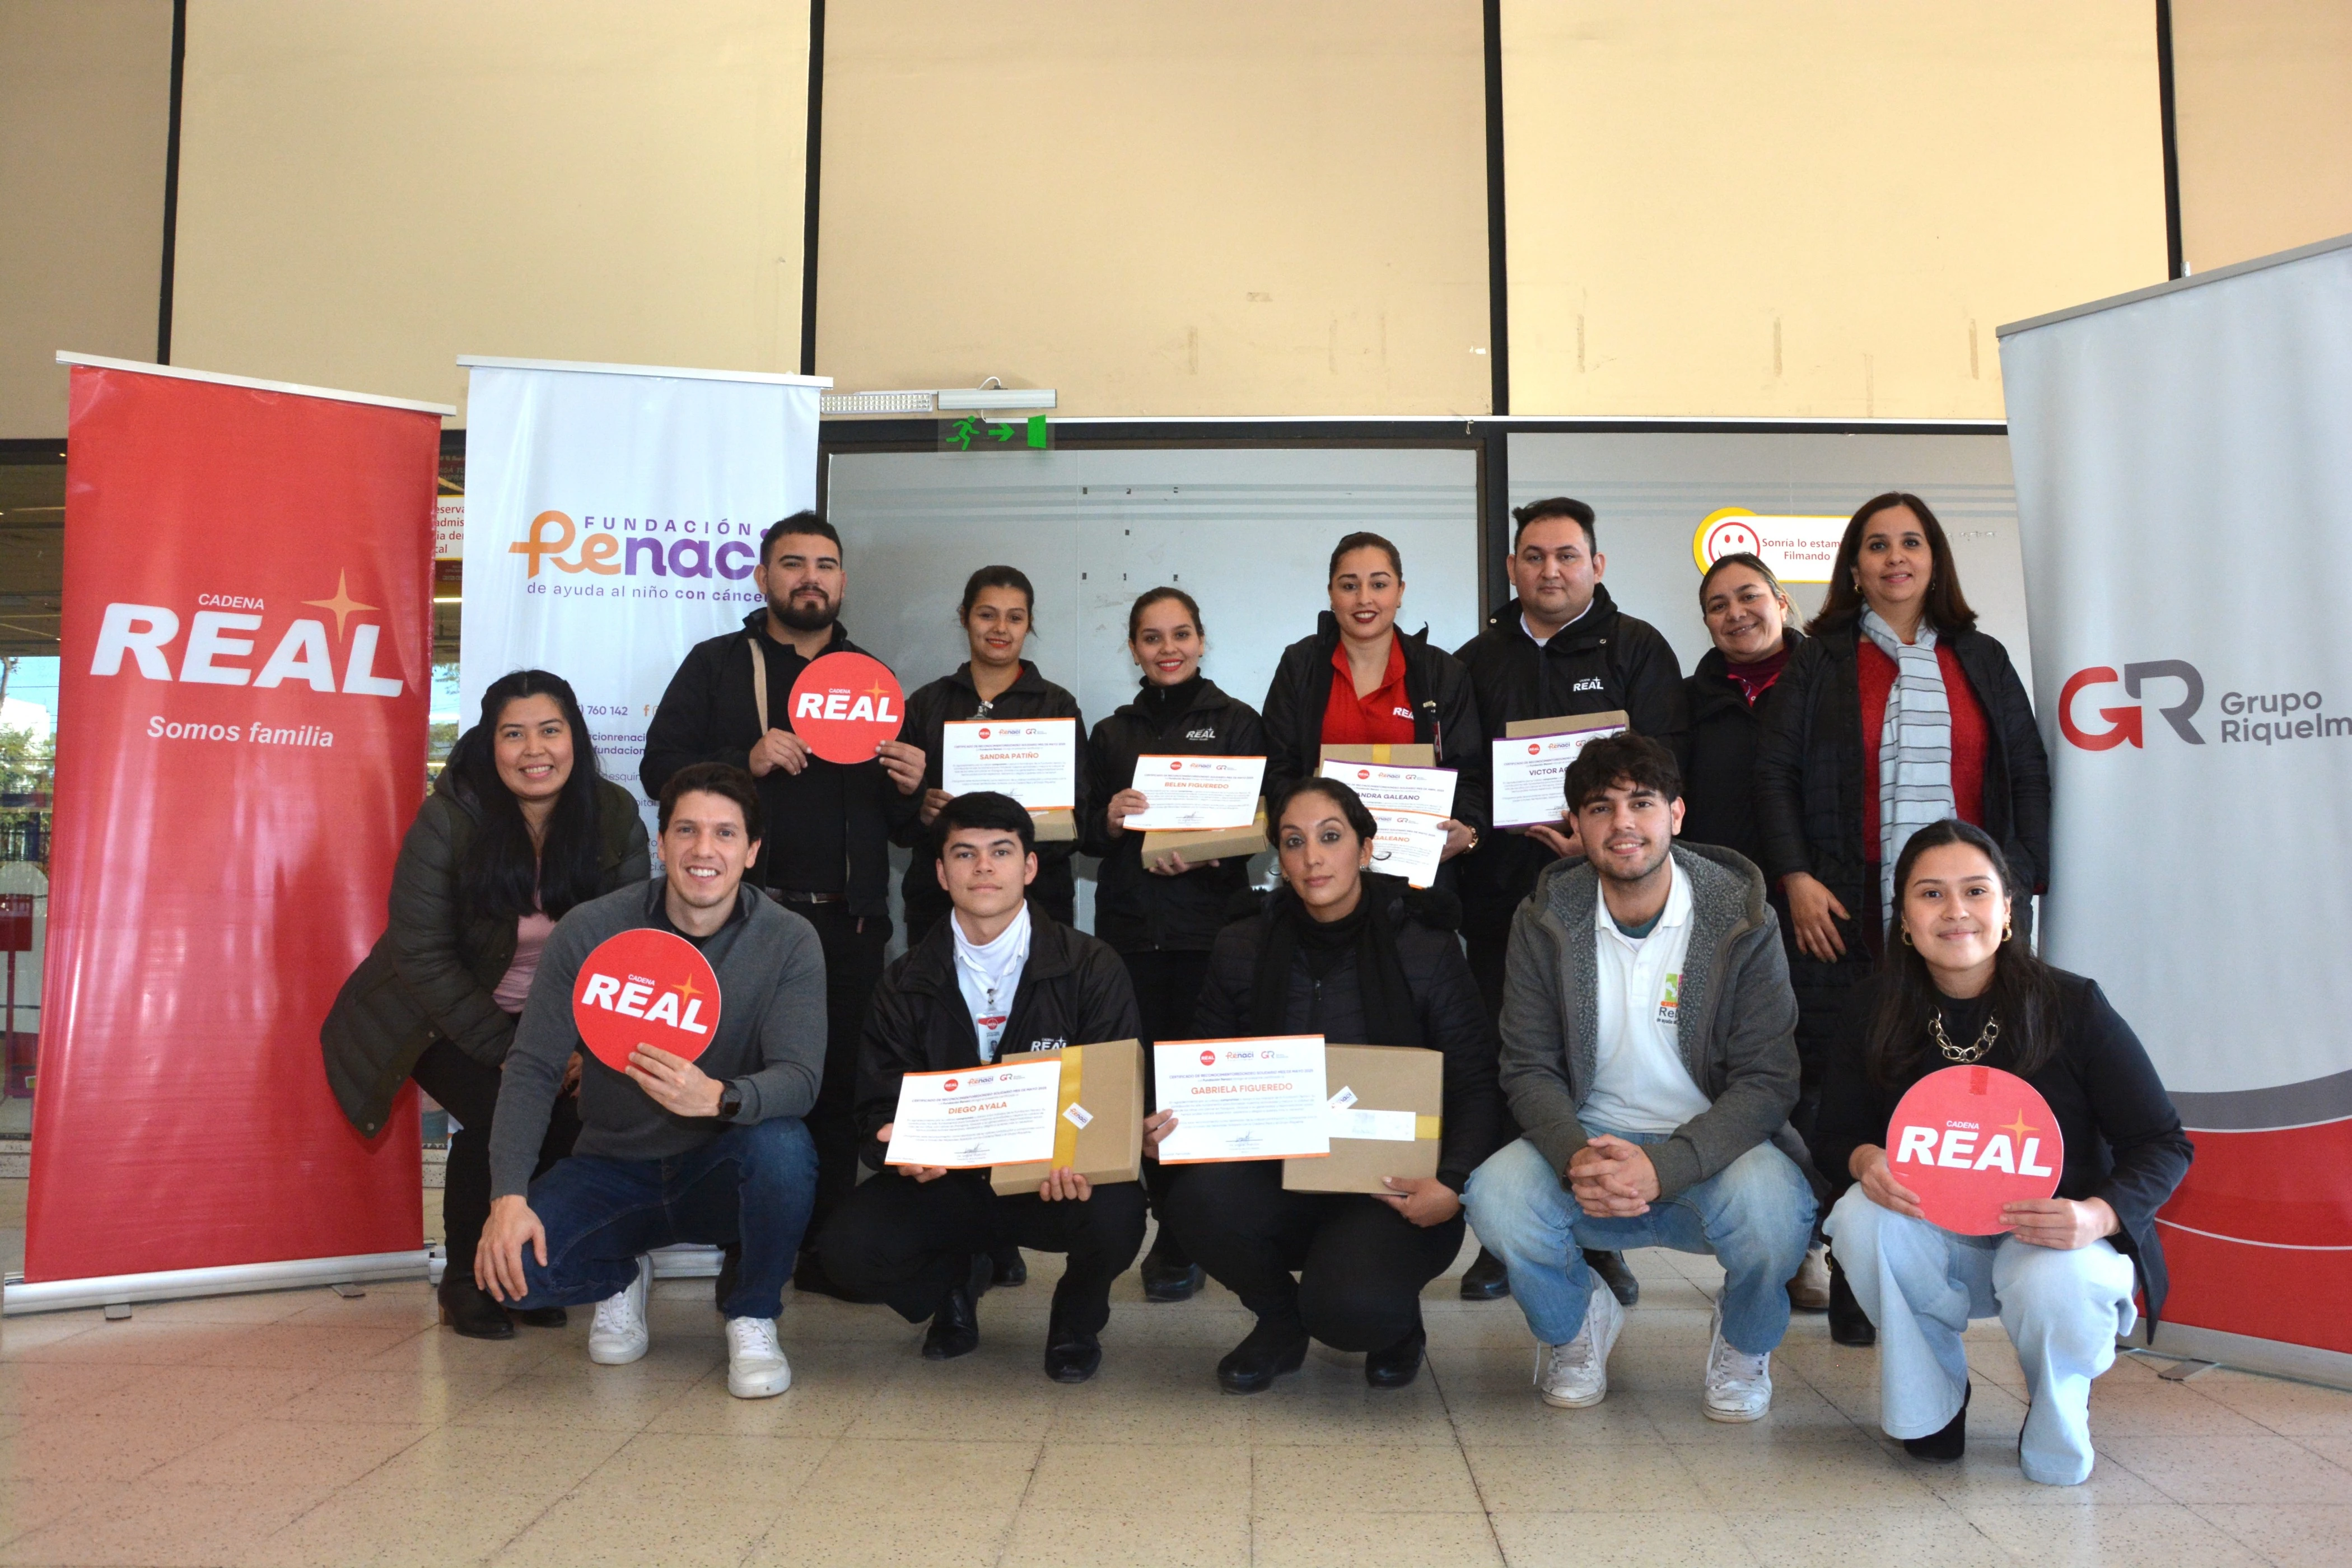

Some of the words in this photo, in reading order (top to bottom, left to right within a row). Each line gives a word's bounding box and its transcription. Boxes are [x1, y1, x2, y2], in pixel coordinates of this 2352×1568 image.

[585, 516, 750, 535] FUNDACIÓN
[1798, 539, 1807, 547] lo
[1784, 551, 1830, 560] Filmando
[528, 582, 546, 594] de
[553, 584, 604, 598] ayuda
[611, 586, 624, 597] al
[632, 586, 668, 599] niño
[675, 590, 705, 600] con
[198, 594, 264, 610] CADENA
[90, 603, 403, 697] REAL
[1573, 682, 1604, 692] REAL
[587, 706, 606, 715] 760
[610, 706, 628, 716] 142
[796, 693, 898, 722] REAL
[2059, 659, 2206, 751] GR
[2220, 691, 2322, 716] Grupo
[147, 716, 240, 742] Somos
[249, 722, 334, 748] familia
[2221, 713, 2352, 745] Riquelm
[628, 974, 655, 986] CADENA
[581, 973, 708, 1034] REAL
[1225, 1051, 1253, 1060] Renaci
[1191, 1085, 1237, 1094] GABRIELA
[1240, 1083, 1292, 1092] FIGUEREDO
[948, 1105, 977, 1114] DIEGO
[978, 1102, 1007, 1111] AYALA
[1947, 1121, 1979, 1130] CADENA
[1896, 1126, 2052, 1177] REAL
